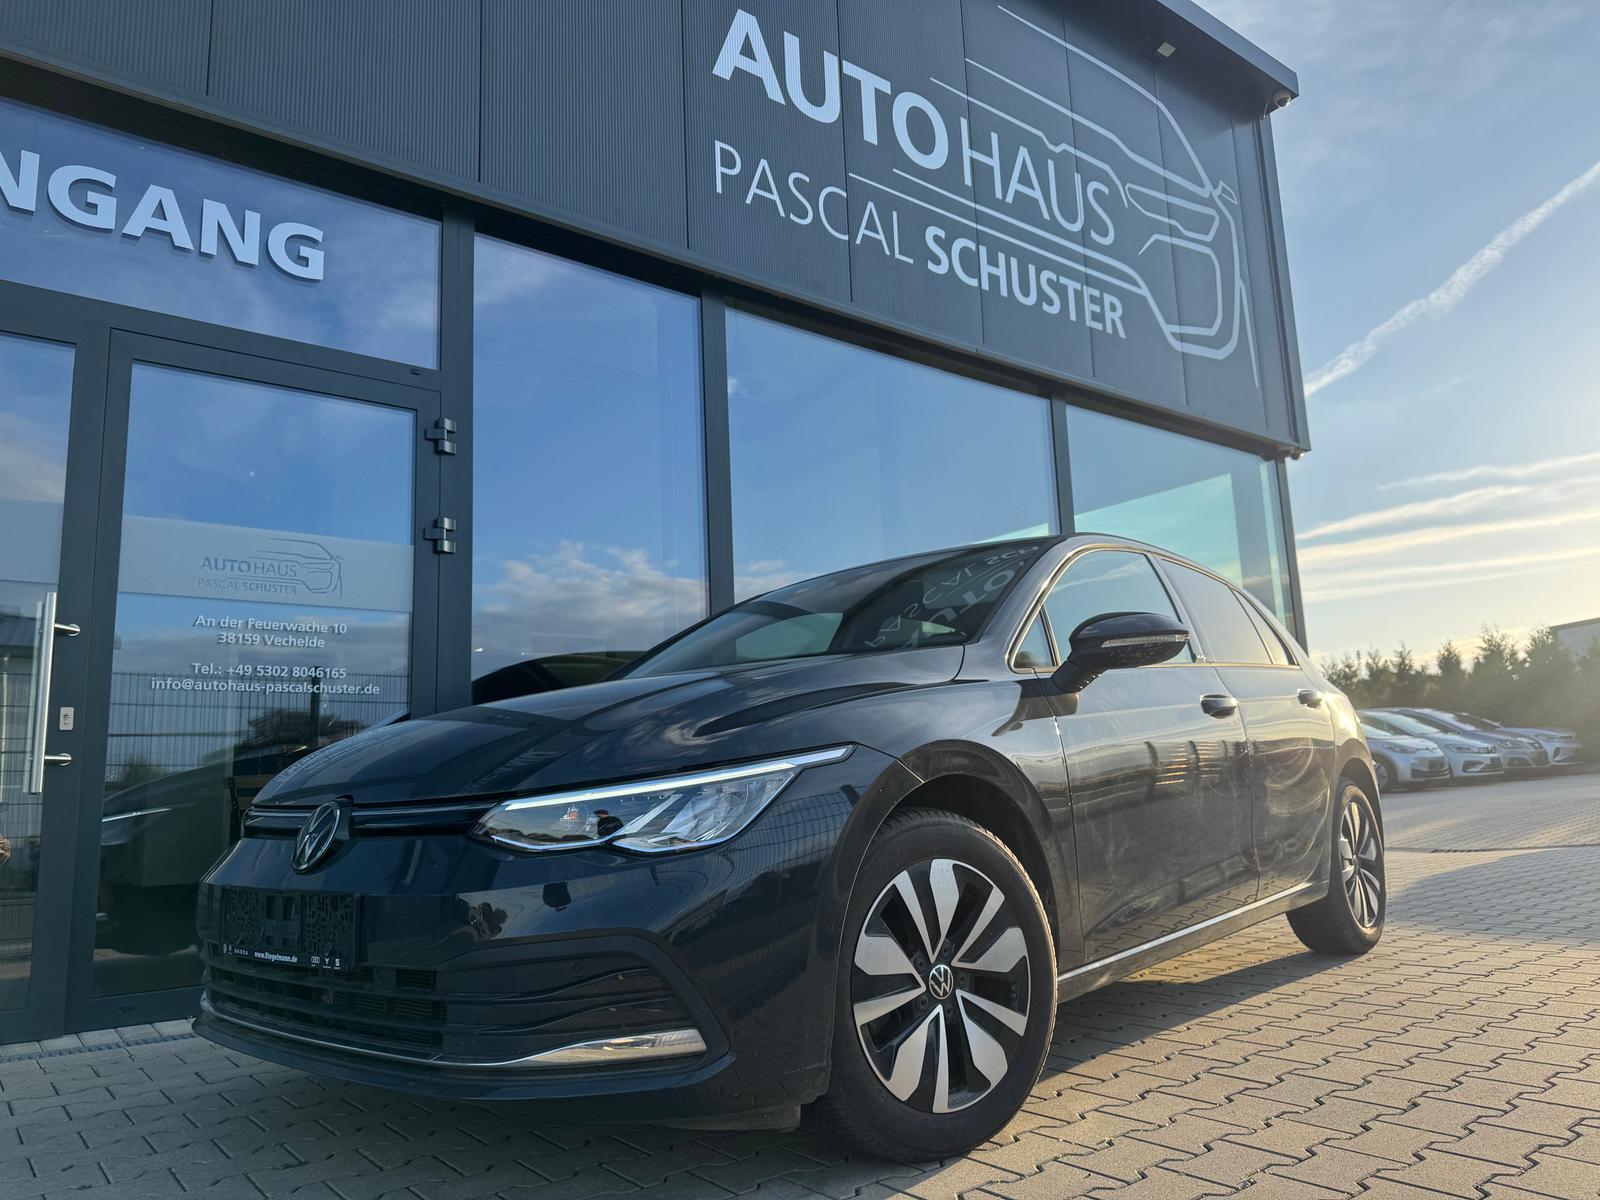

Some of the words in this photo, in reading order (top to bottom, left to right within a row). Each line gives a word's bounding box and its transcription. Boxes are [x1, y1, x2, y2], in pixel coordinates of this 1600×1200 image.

[714, 139, 914, 264] PASCAL
[924, 225, 1127, 339] SCHUSTER
[198, 577, 240, 591] PASCAL
[242, 581, 297, 595] SCHUSTER
[193, 615, 216, 628] An
[219, 616, 243, 628] der
[247, 618, 329, 633] Feuerwache
[332, 623, 348, 634] 10
[217, 632, 260, 645] 38159
[264, 634, 326, 648] Vechelde
[192, 662, 223, 675] Tel.:
[226, 665, 252, 676] +49
[256, 665, 289, 677] 5302
[292, 667, 347, 679] 8046165
[151, 677, 380, 695] info@autohaus-pascalschuster.de
